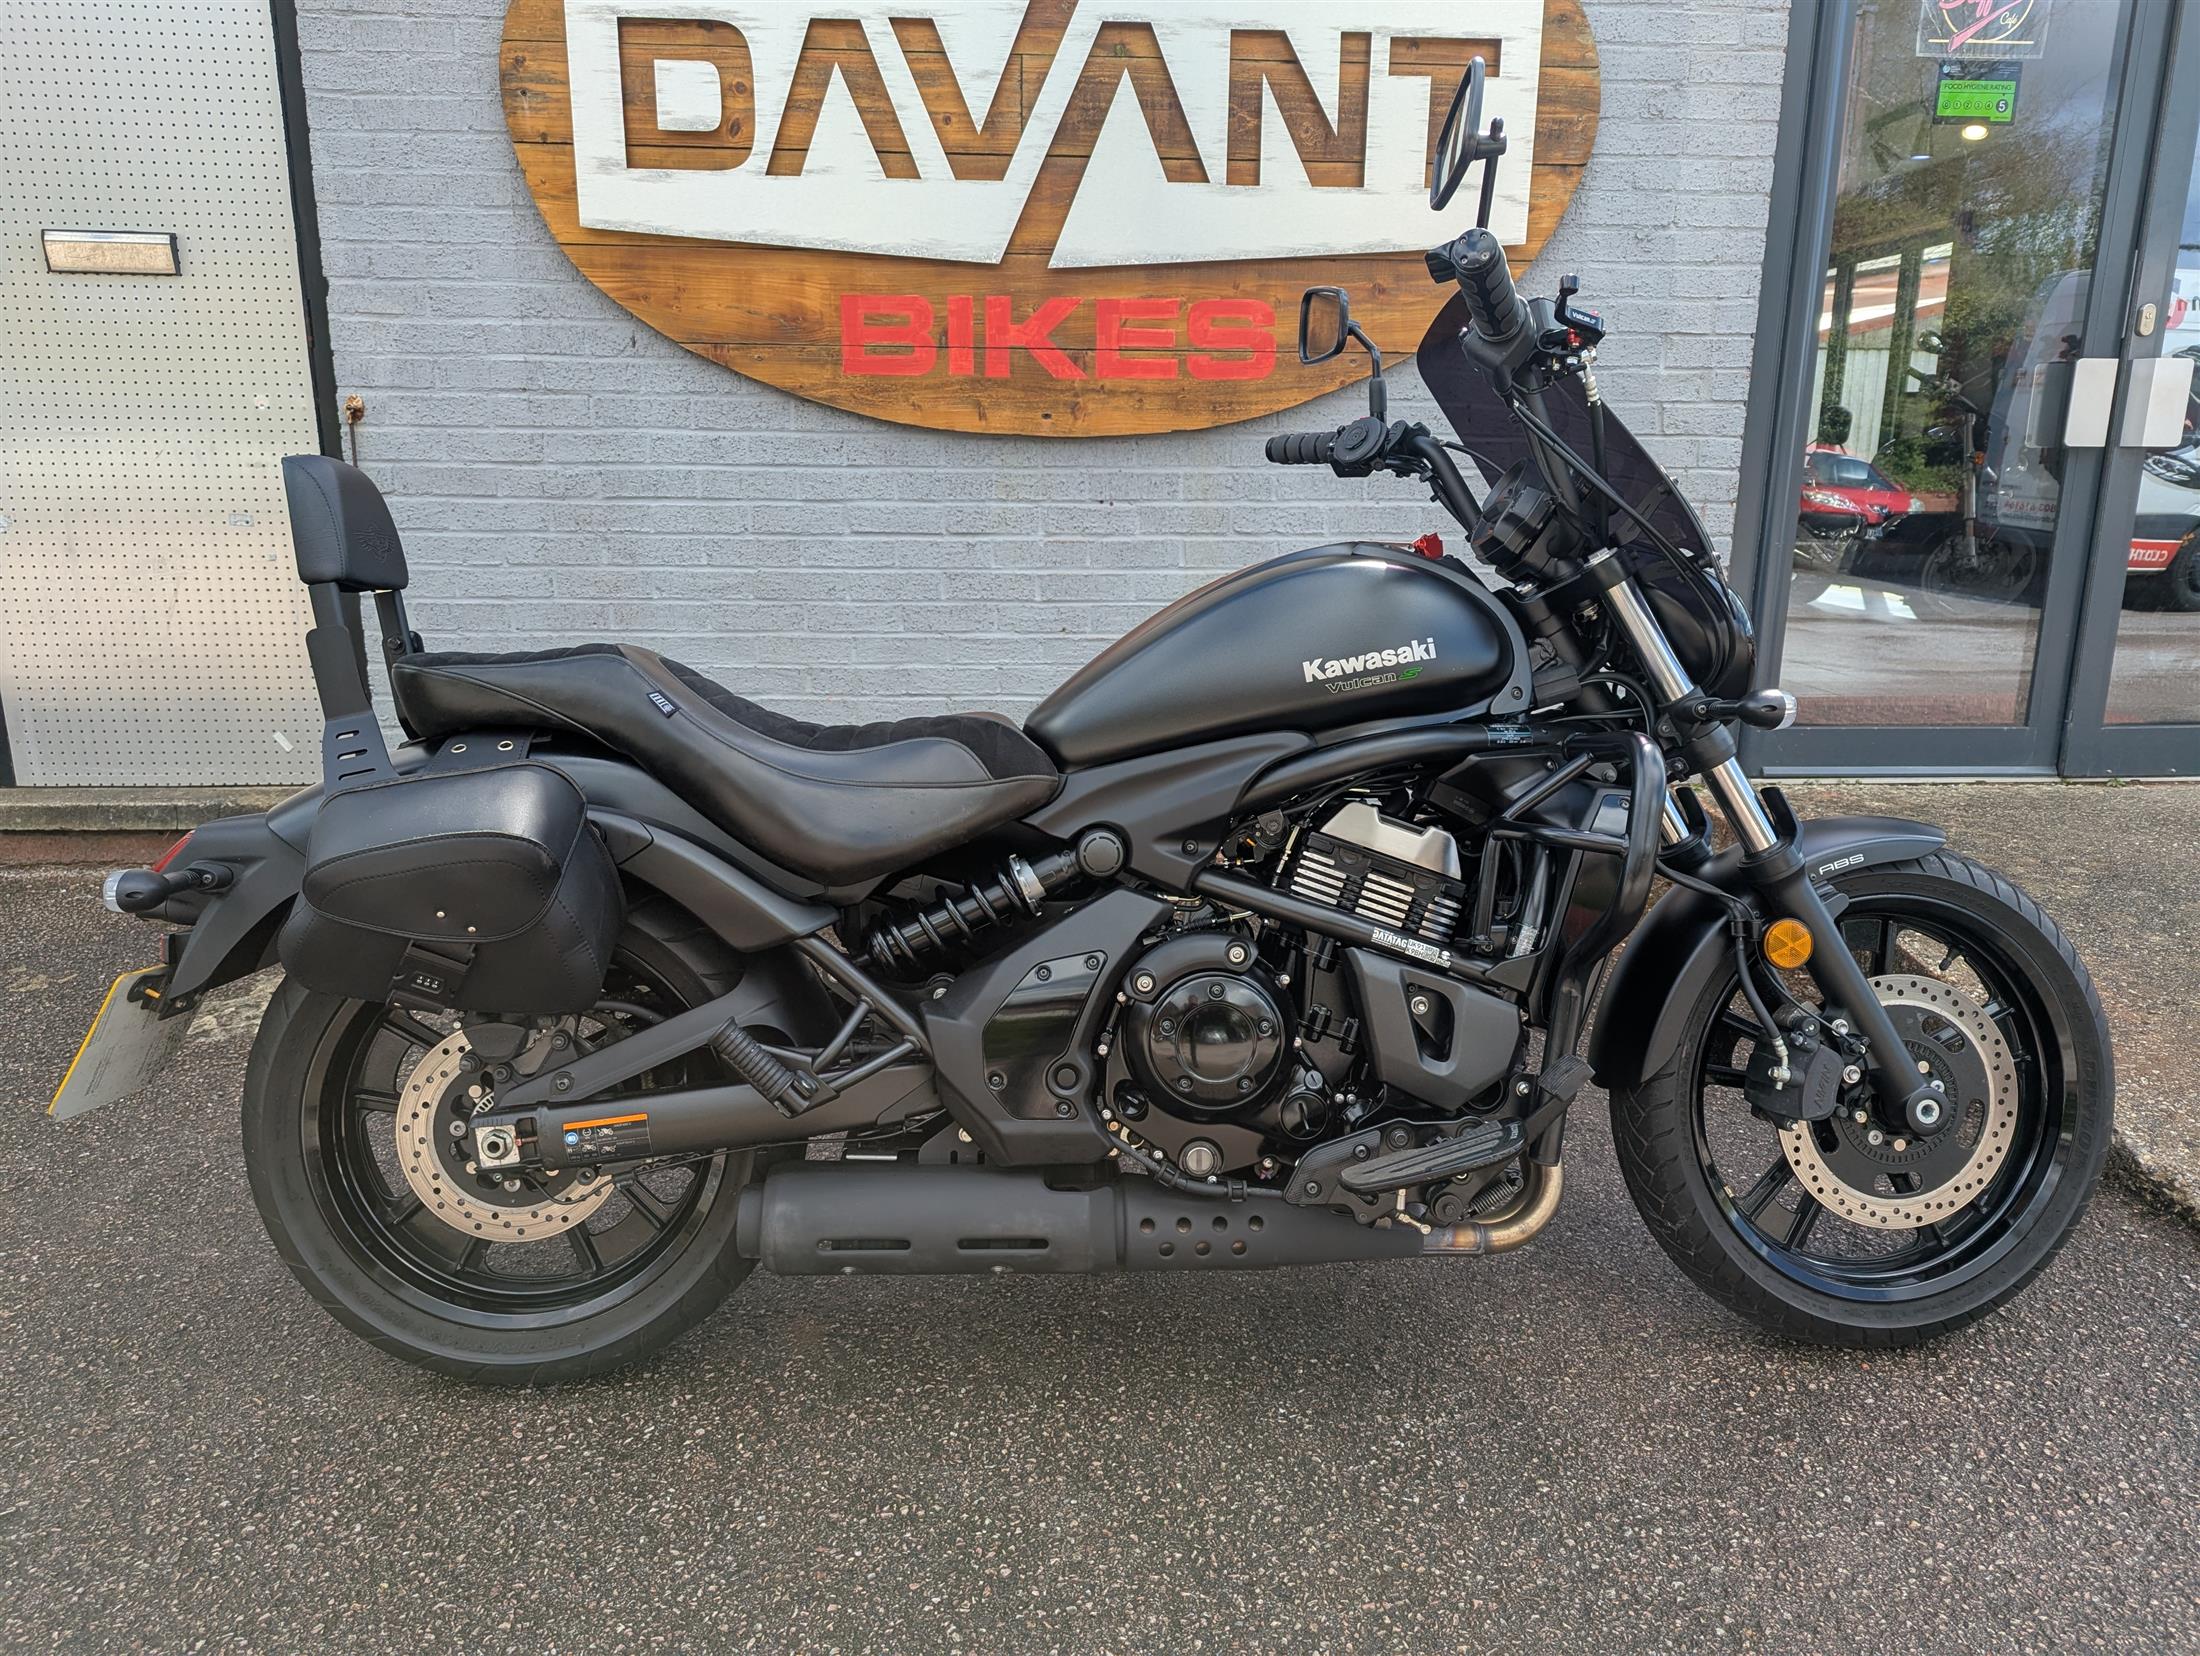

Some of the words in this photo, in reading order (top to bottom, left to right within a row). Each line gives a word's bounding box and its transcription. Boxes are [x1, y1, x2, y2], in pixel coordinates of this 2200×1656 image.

[617, 16, 1502, 188] DAVANT
[1998, 100, 2006, 112] 5
[840, 294, 1277, 380] BIKES
[1302, 637, 1437, 682] Kawasaki
[1325, 672, 1397, 694] Vulcan
[1819, 853, 1864, 875] ABS
[1372, 929, 1408, 948] DATATAG
